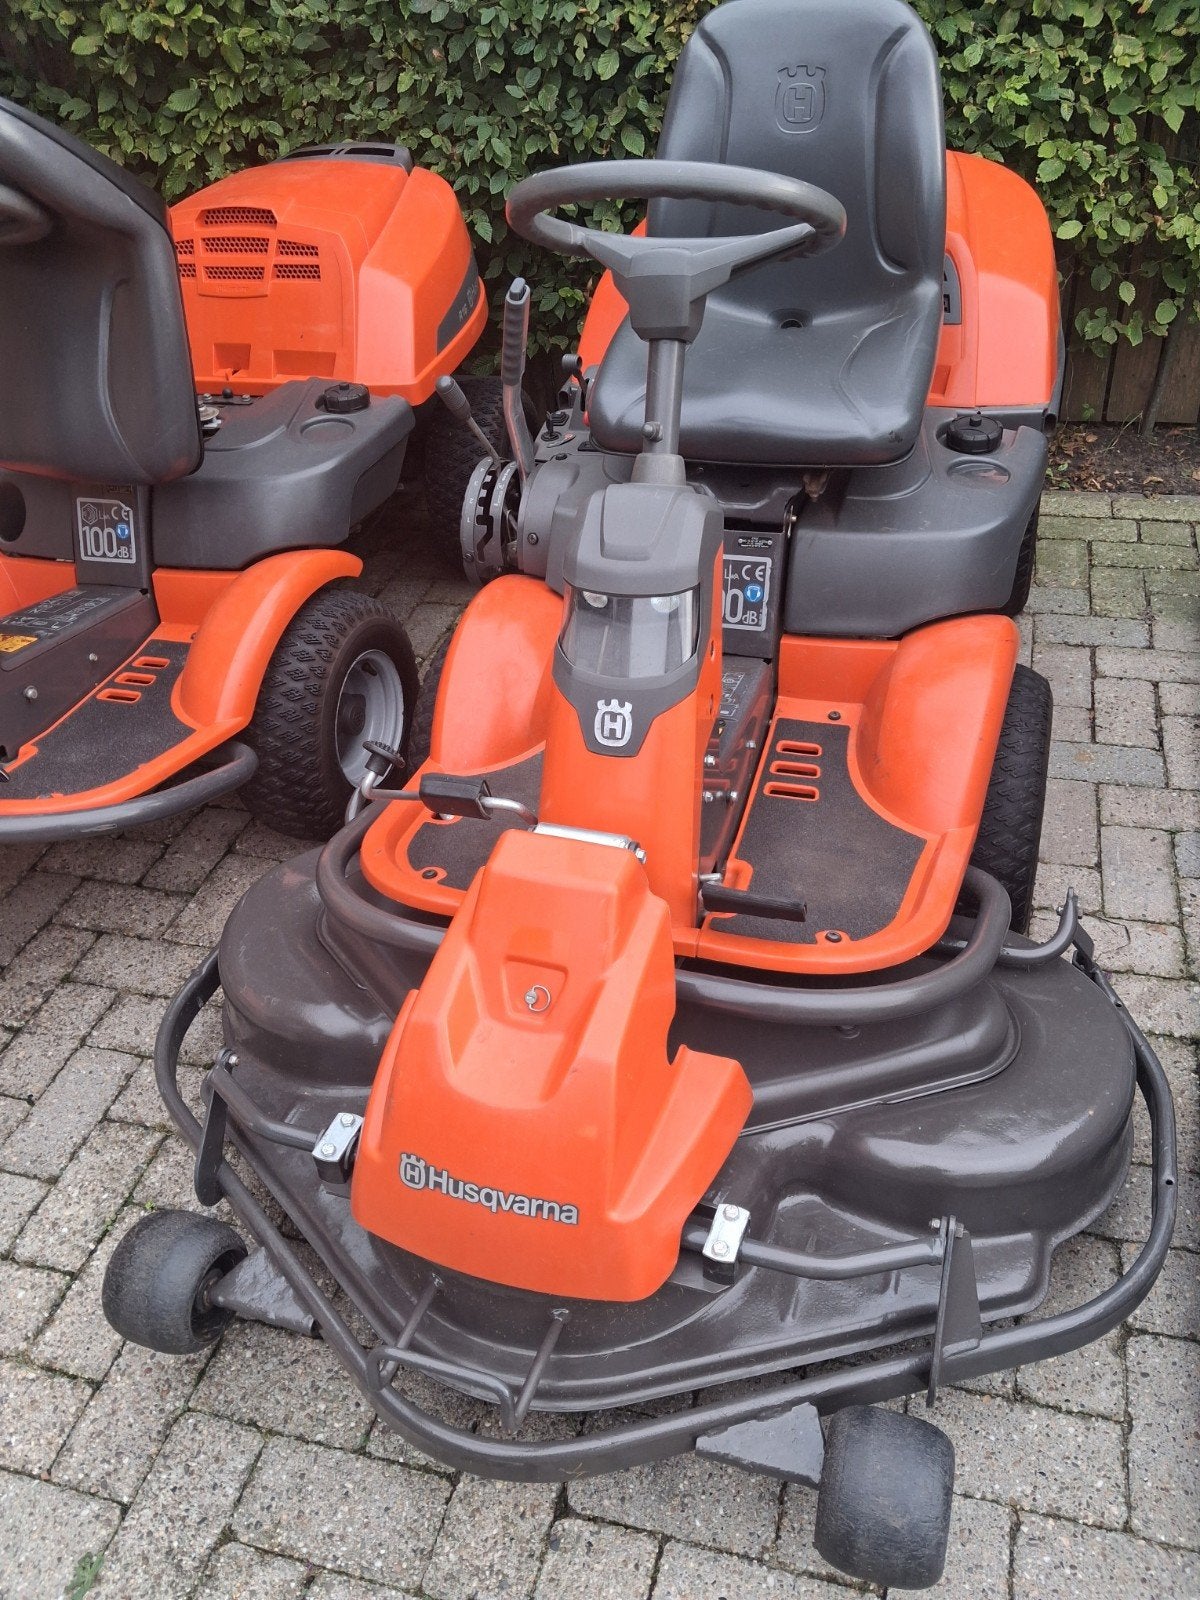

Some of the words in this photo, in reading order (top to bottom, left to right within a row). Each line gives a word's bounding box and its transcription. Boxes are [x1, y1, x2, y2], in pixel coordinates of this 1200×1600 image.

[82, 526, 117, 557] 100
[117, 546, 129, 558] dB
[742, 564, 766, 582] CE
[742, 610, 758, 625] dB
[428, 1165, 579, 1226] Husqvarna
